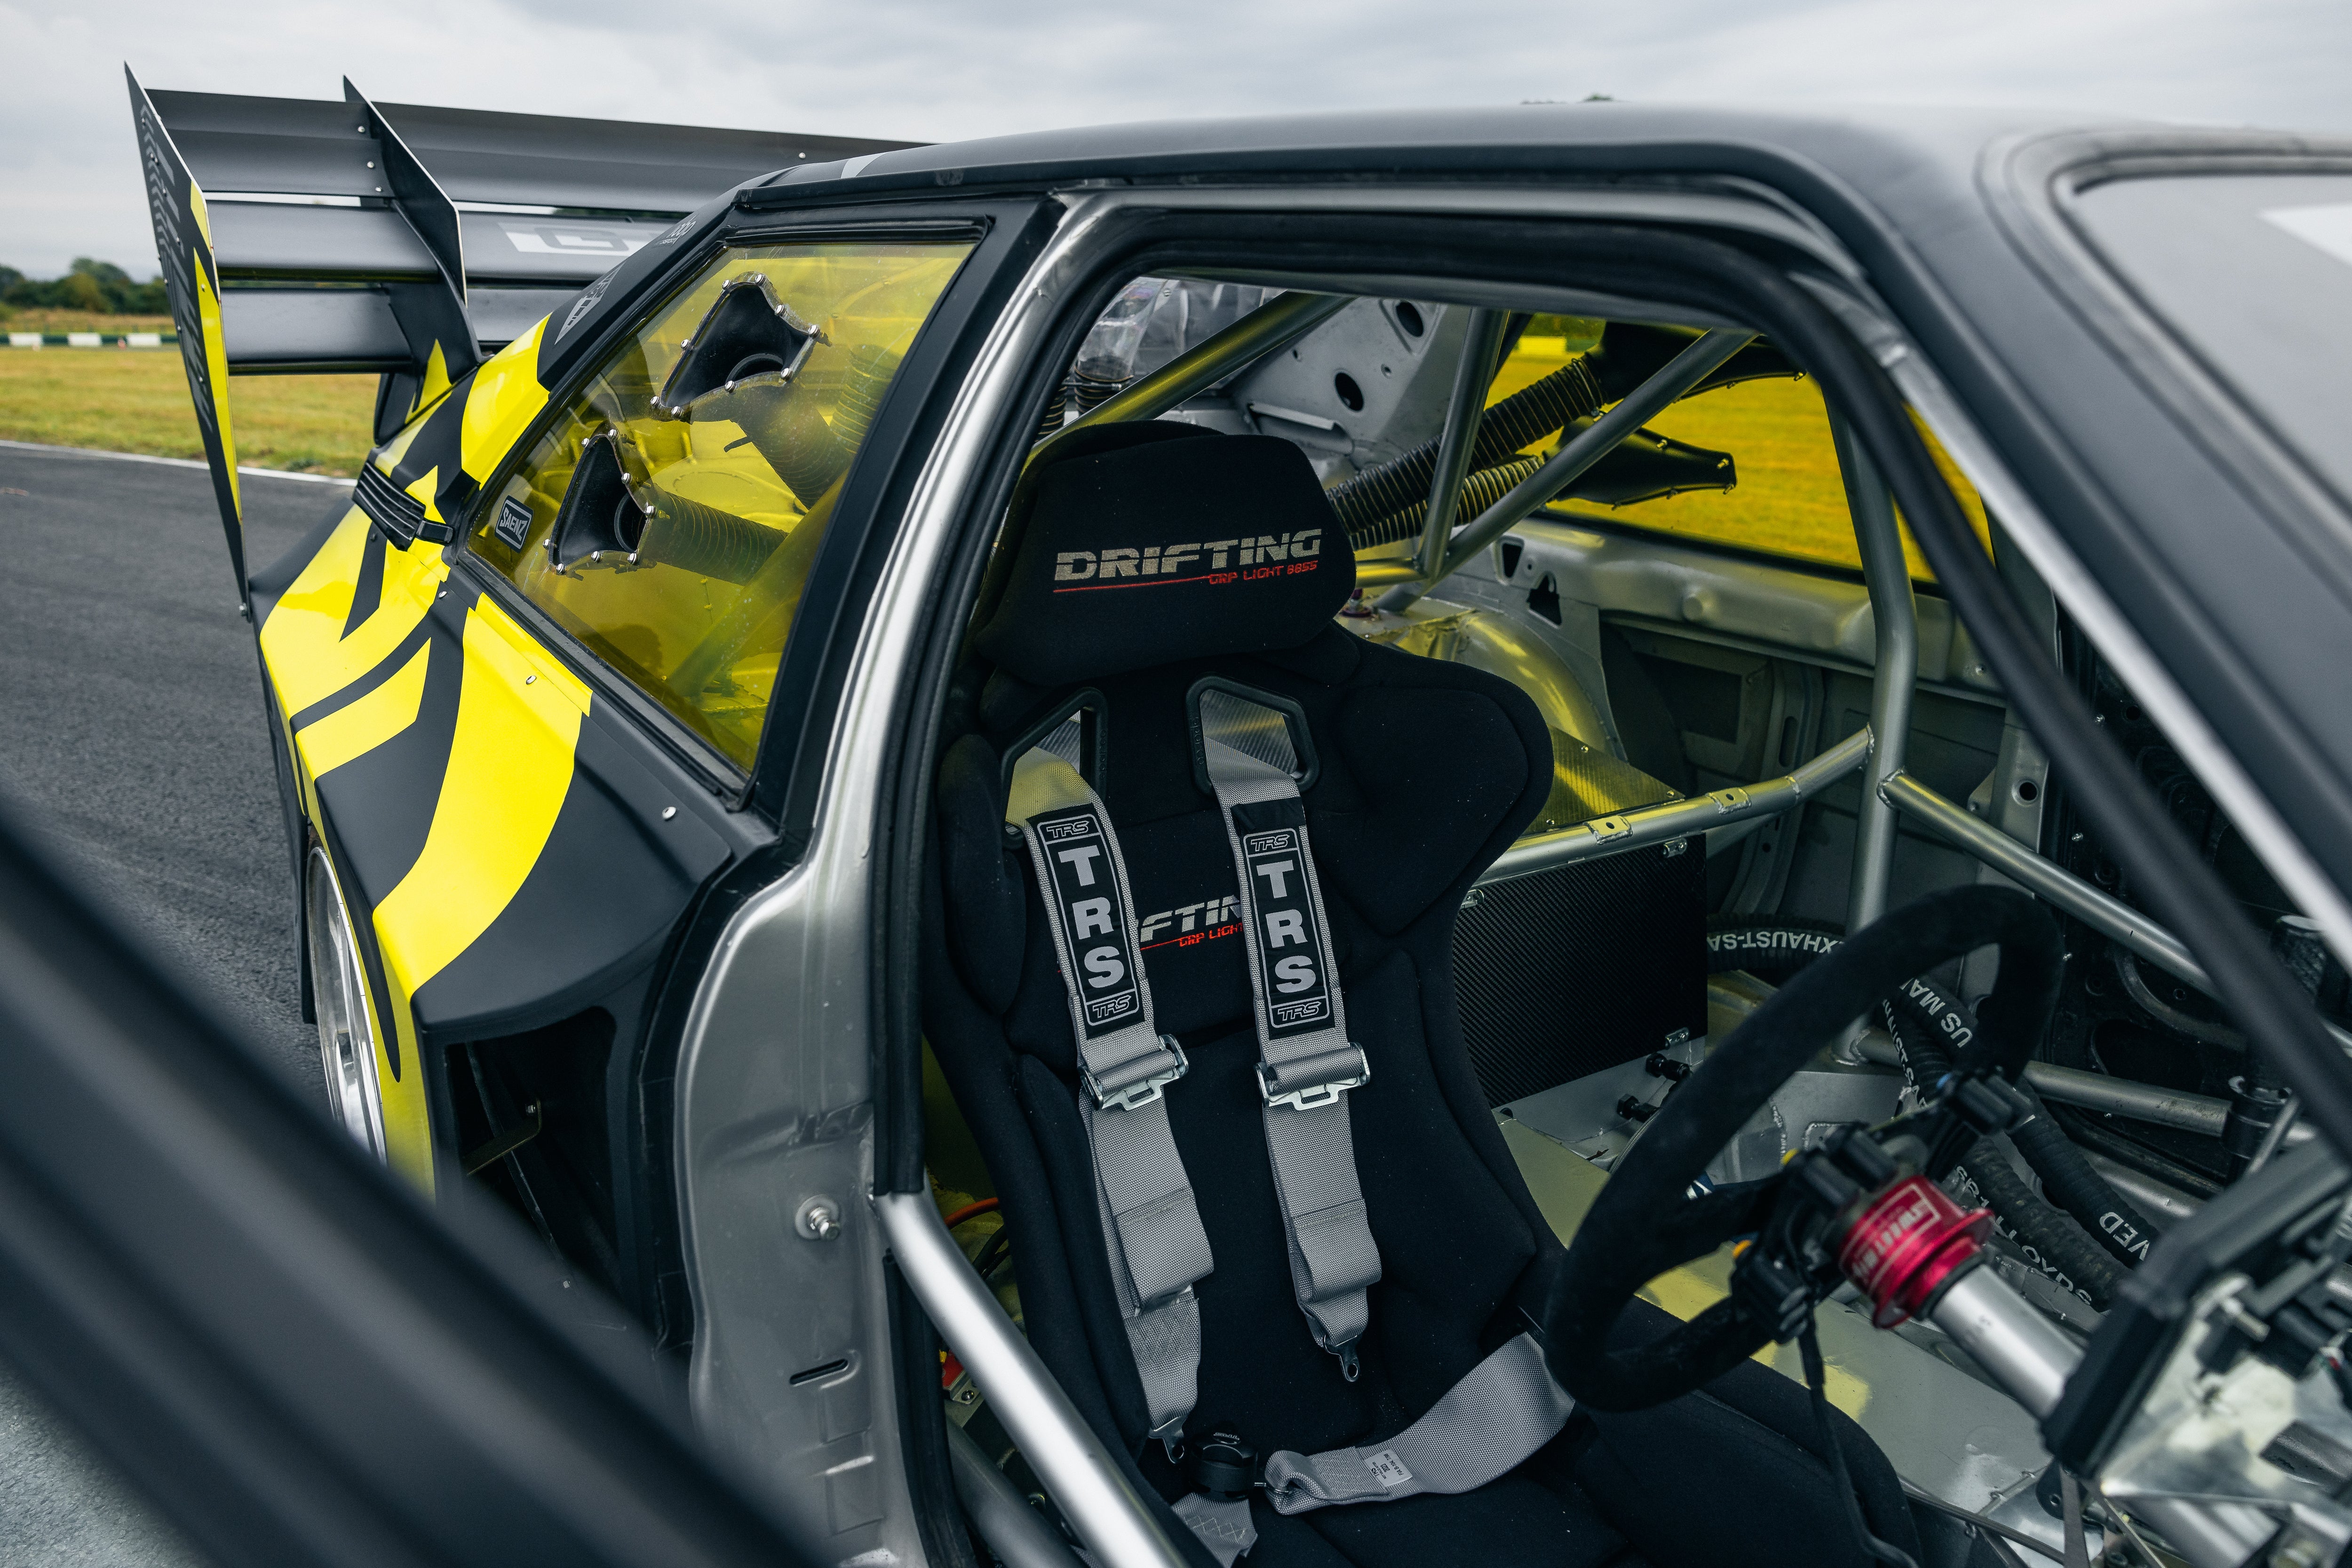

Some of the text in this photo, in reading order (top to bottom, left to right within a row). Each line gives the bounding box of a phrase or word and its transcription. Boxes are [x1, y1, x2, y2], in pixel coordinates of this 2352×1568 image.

[500, 507, 528, 541] SAENZ
[1054, 529, 1322, 581] DRIFTING
[1209, 572, 1238, 584] GRP
[1243, 565, 1284, 581] LIGHT
[1046, 820, 1089, 838] TRS
[1250, 834, 1290, 851] TRS
[1058, 845, 1124, 988] TRS
[1135, 894, 1242, 942] FTIN
[1256, 860, 1316, 993] TRS
[1179, 932, 1205, 947] GRP
[1708, 931, 1843, 954] XHAUST-SA
[1093, 995, 1131, 1018] TRS
[1277, 1001, 1321, 1021] TRS
[1899, 978, 1973, 1048] US MA
[2099, 1212, 2150, 1261] VED
[1380, 1464, 1390, 1472] 2023
